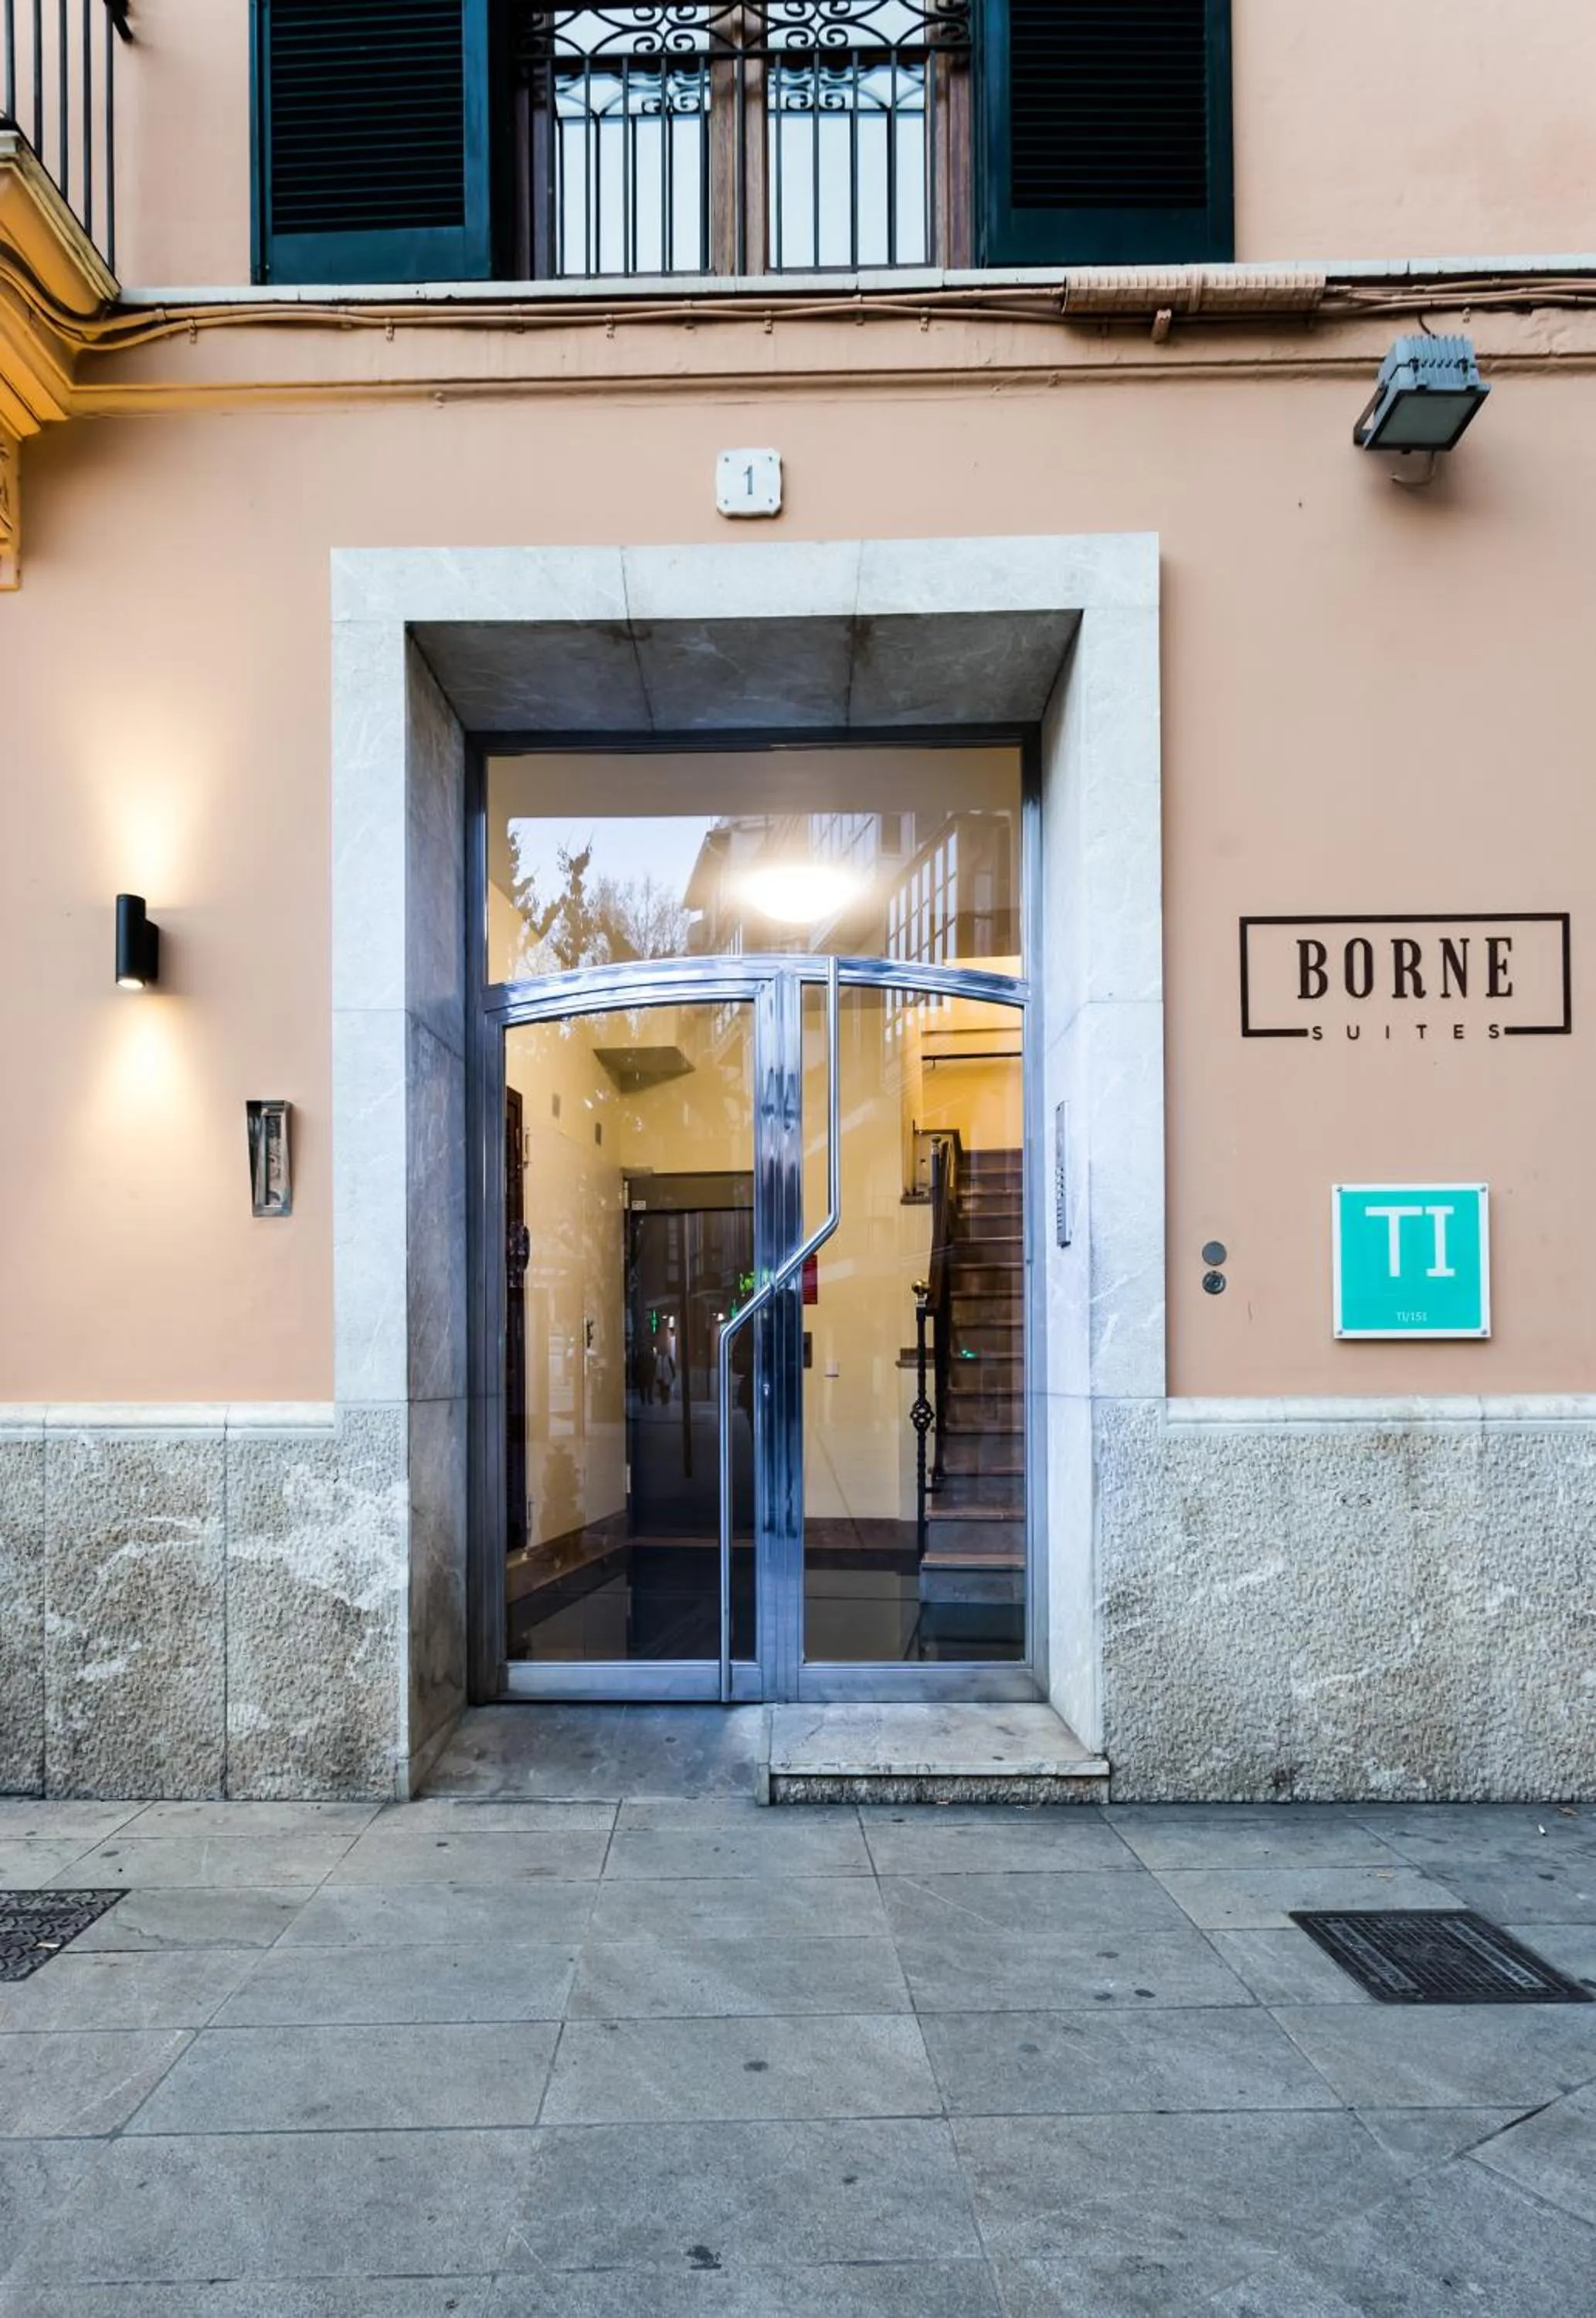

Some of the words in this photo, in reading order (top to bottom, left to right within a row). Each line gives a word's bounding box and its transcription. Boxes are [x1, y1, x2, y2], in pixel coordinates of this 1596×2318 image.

[743, 465, 753, 495] 1
[1297, 937, 1513, 999] BORNE
[1312, 1025, 1499, 1041] SUITES
[1365, 1206, 1455, 1277] TI
